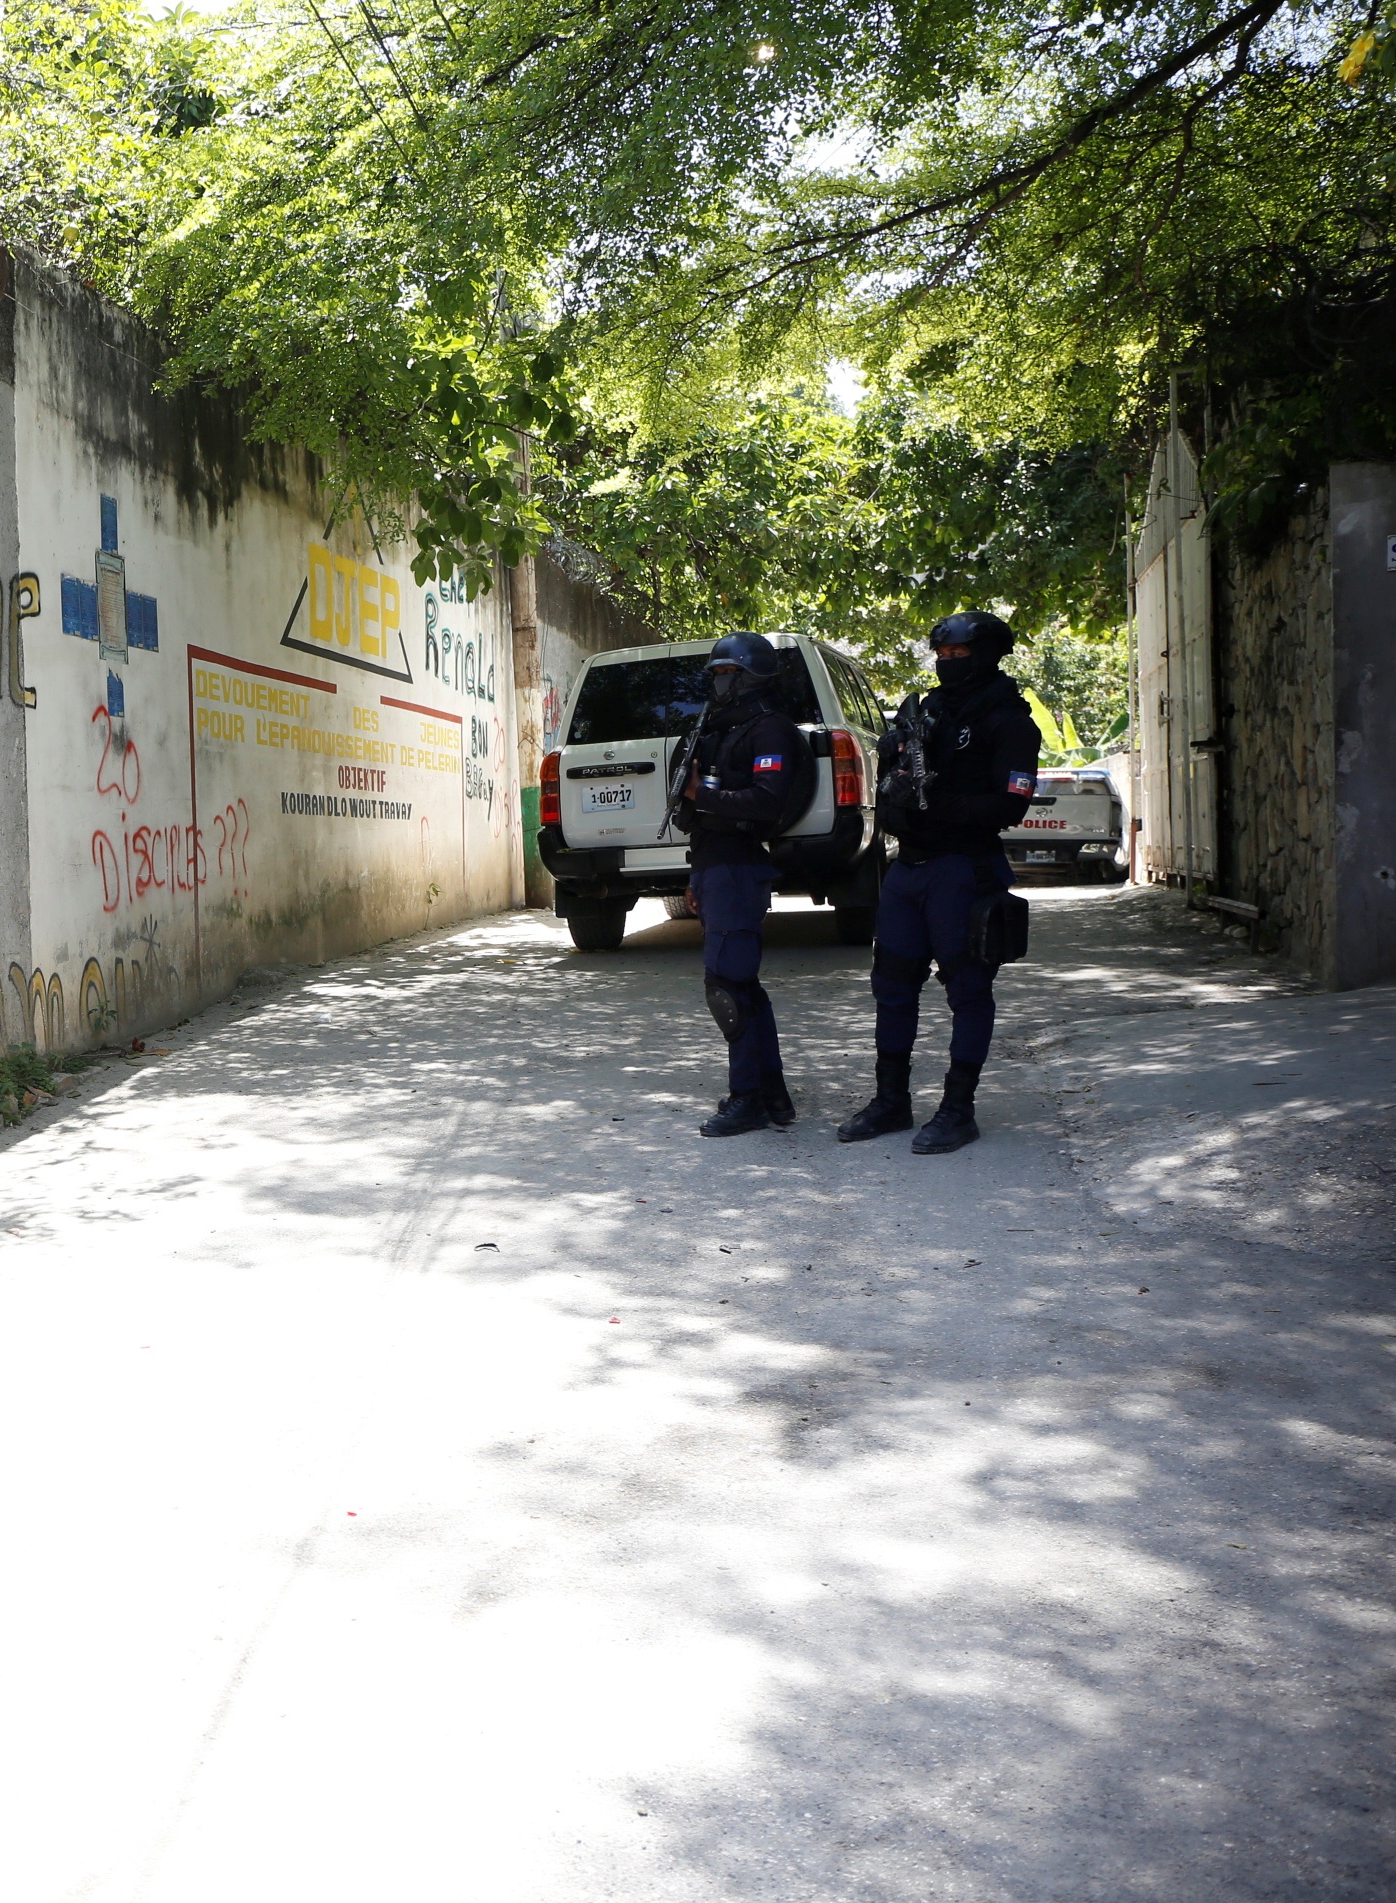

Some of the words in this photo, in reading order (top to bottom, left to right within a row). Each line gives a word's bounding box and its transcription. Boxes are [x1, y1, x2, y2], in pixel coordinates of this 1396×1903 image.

[309, 541, 400, 659] DJEP
[195, 668, 311, 719] DEVOUEMENT
[352, 706, 379, 733] DES
[419, 721, 461, 750] JEUNES
[196, 707, 245, 743] POUR
[256, 711, 397, 764] L'EPANOUISSEMENT
[400, 745, 415, 767] DE
[417, 749, 461, 774] PELERIN
[92, 705, 141, 805] 20
[337, 765, 387, 793] OBJEKTIF
[582, 765, 633, 775] PATROL
[281, 792, 324, 816] KOURAN
[326, 796, 347, 818] DLO
[349, 798, 376, 819] WOUT
[378, 800, 412, 820] TRAVAY
